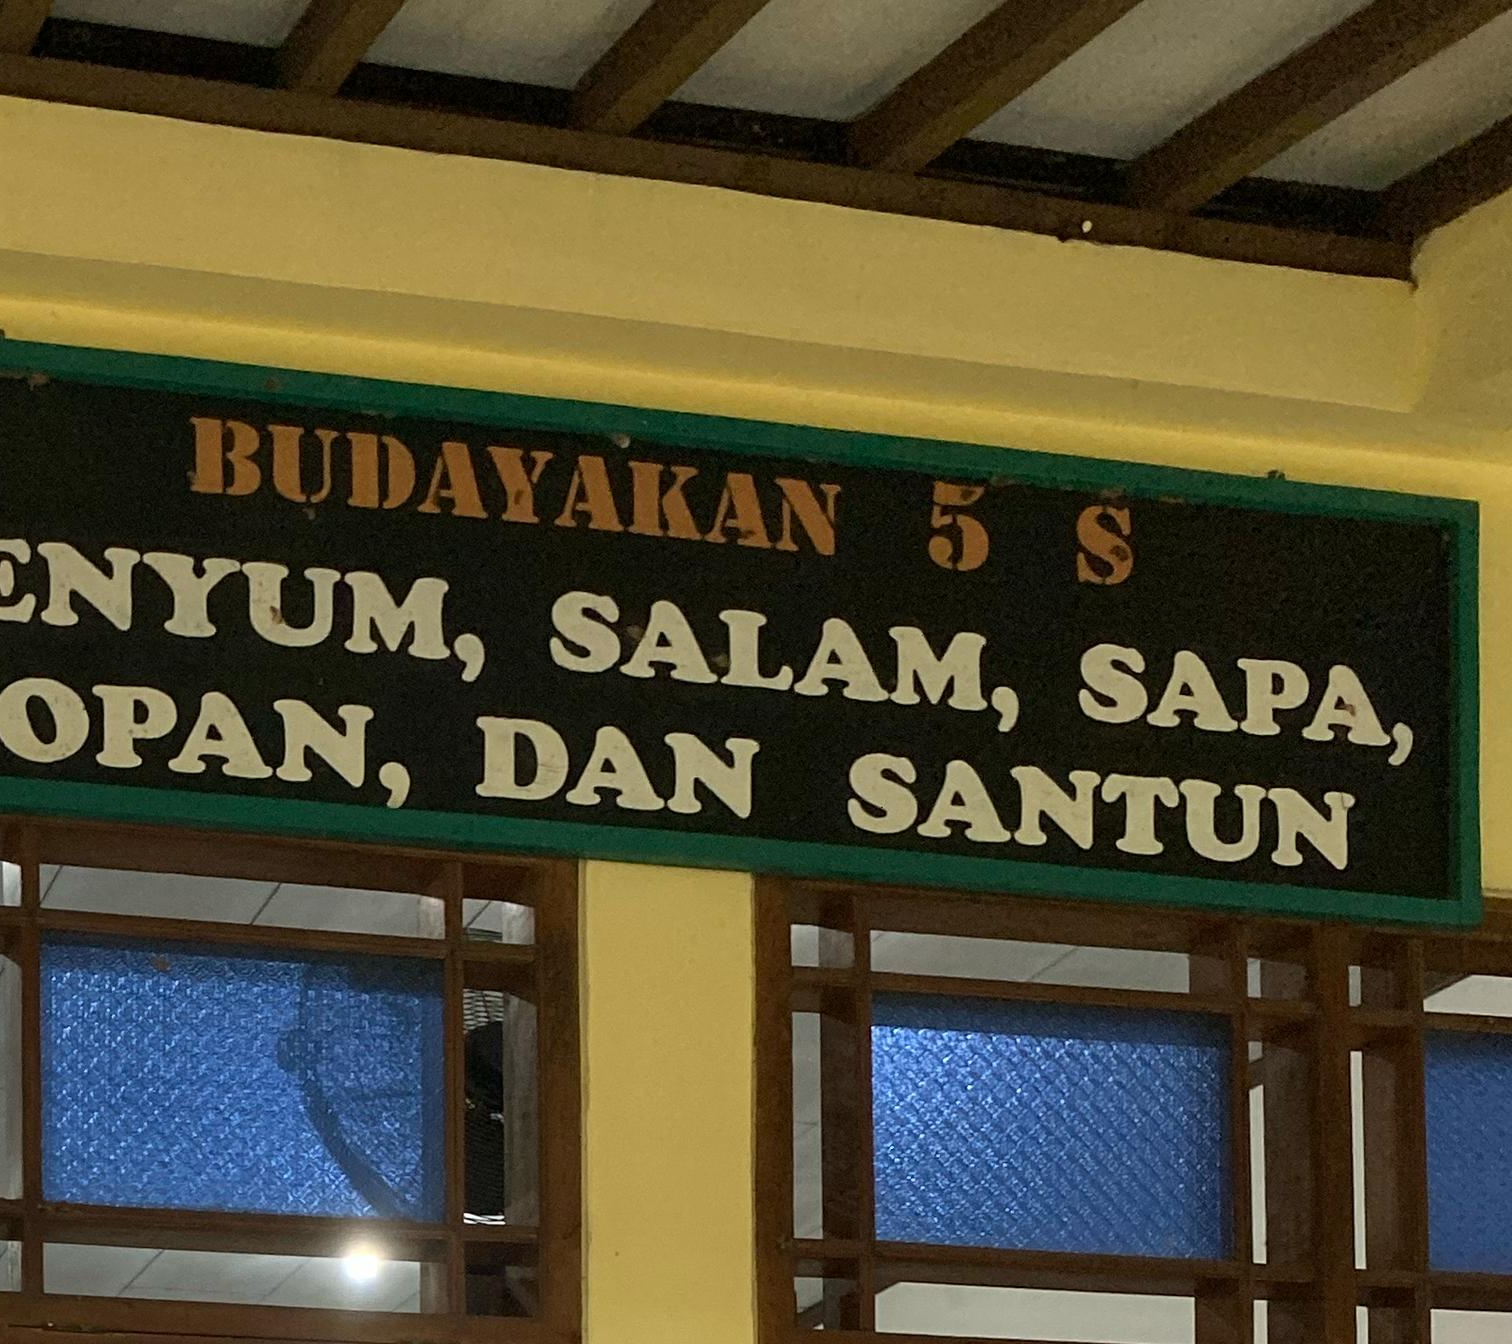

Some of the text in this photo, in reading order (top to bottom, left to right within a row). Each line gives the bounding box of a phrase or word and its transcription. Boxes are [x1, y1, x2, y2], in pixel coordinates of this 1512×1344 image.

[190, 416, 1134, 585] BUDAYAKAN 5 S
[549, 590, 1019, 732] SALAM,
[1078, 643, 1414, 766] SAPA,
[475, 716, 760, 819] DAN
[847, 753, 1349, 870] SANTUN
